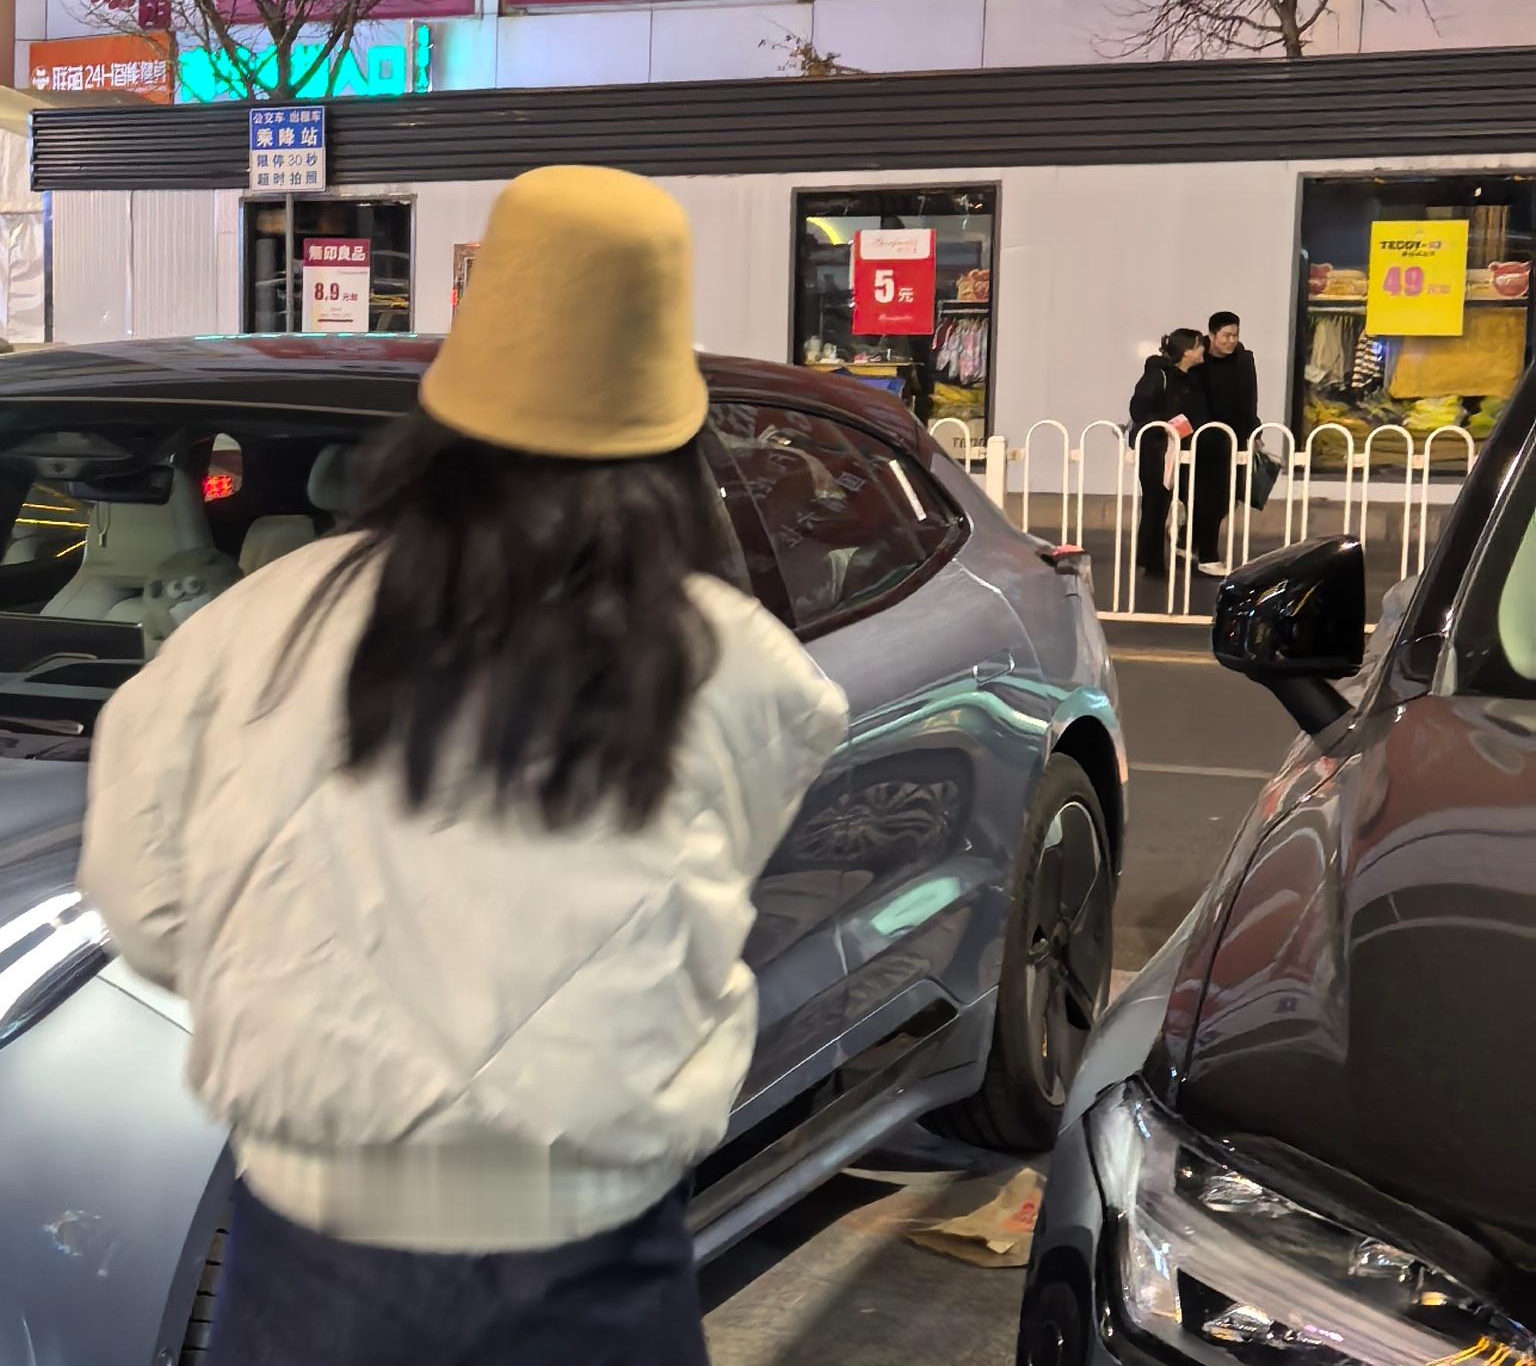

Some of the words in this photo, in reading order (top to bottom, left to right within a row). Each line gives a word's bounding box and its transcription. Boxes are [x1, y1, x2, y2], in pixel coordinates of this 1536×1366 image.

[253, 112, 285, 124] 公交车
[256, 126, 319, 147] 乘降站
